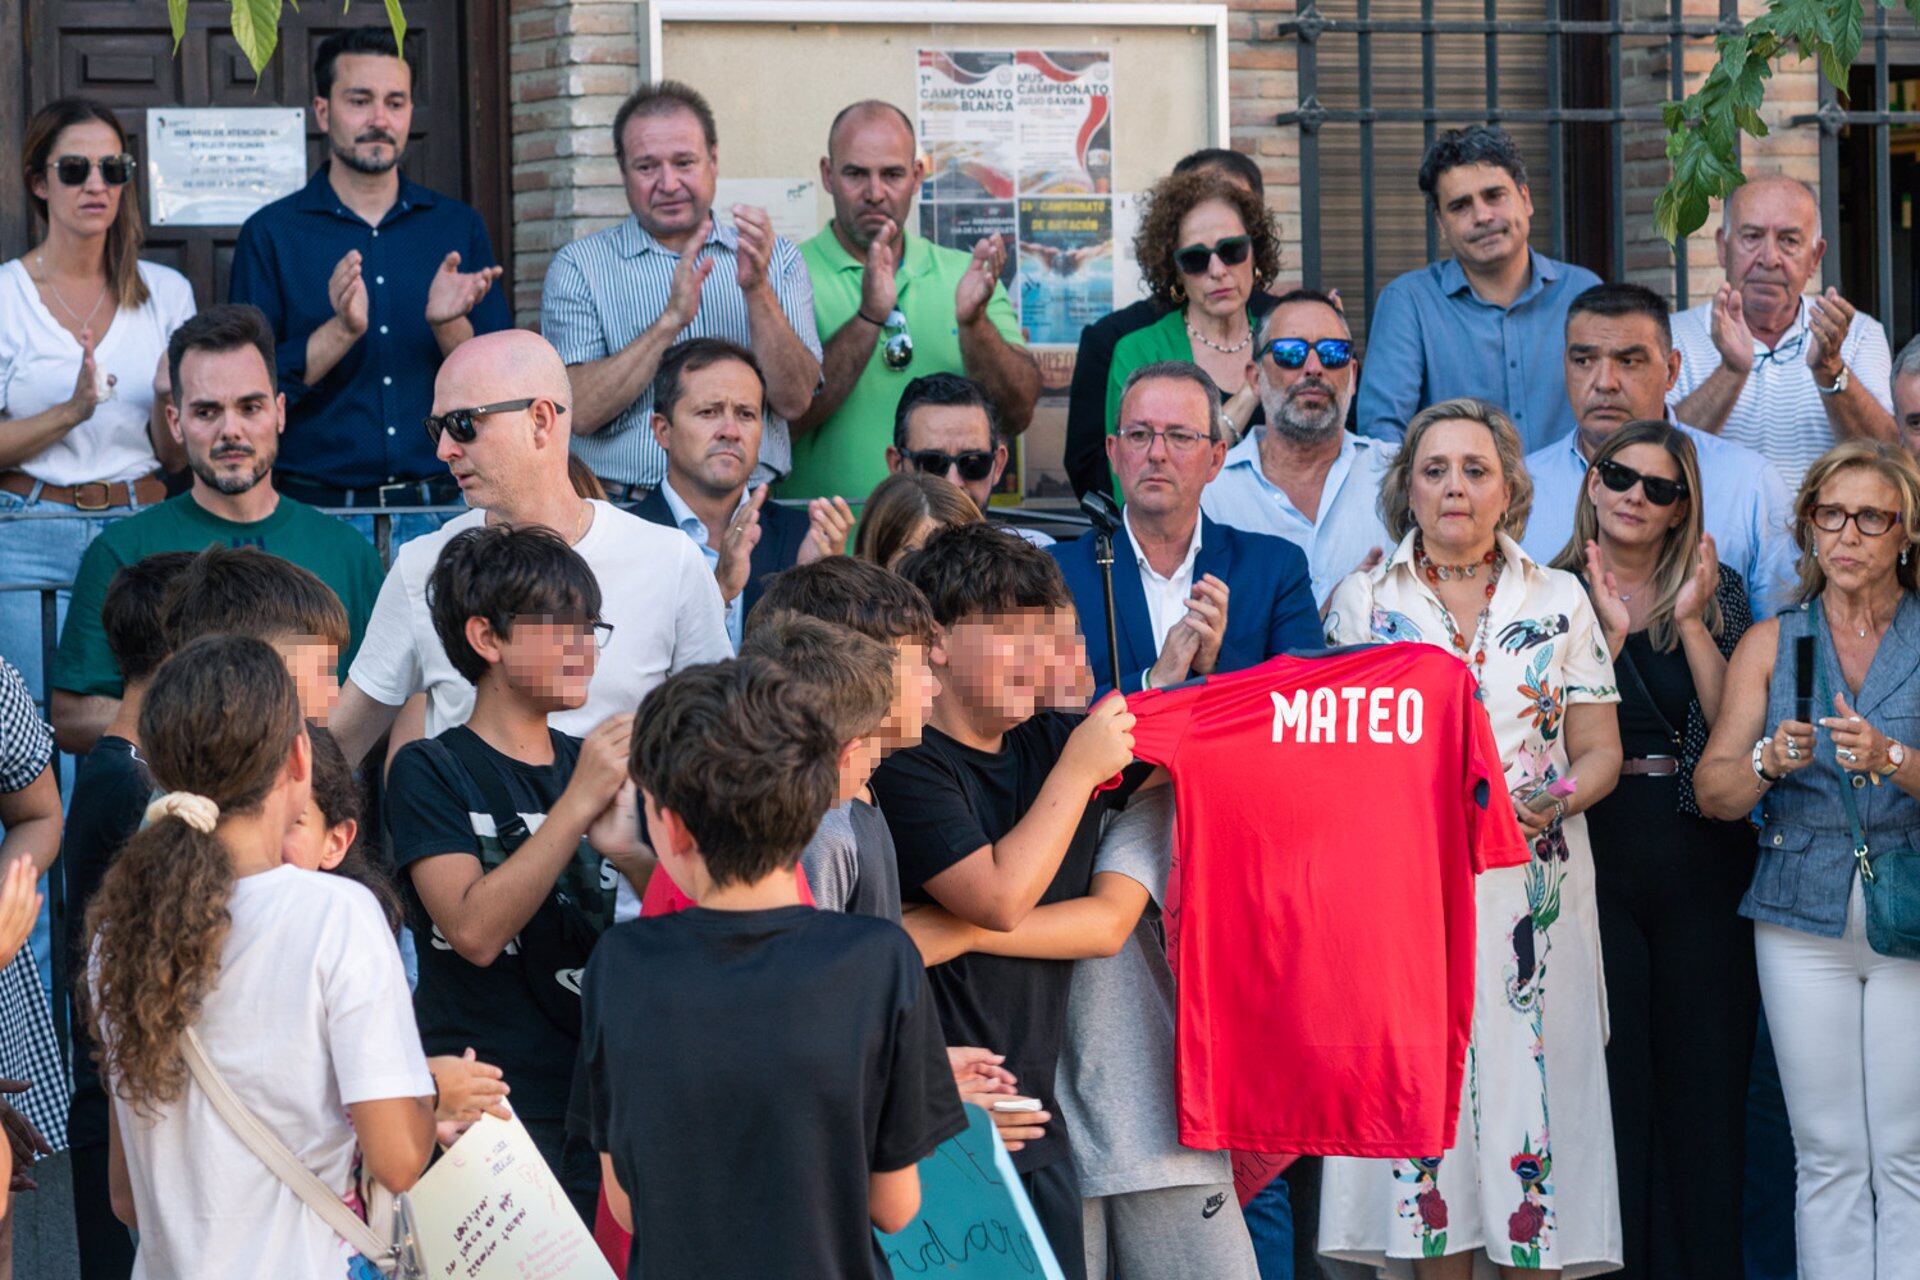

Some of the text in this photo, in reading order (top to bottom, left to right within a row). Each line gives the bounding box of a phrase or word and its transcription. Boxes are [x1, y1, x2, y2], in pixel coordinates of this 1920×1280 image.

[920, 88, 1013, 100] CAMPEONATO
[1017, 84, 1109, 95] CAMPEONATO
[961, 100, 1014, 112] BLANCA
[1270, 686, 1424, 744] MATEO
